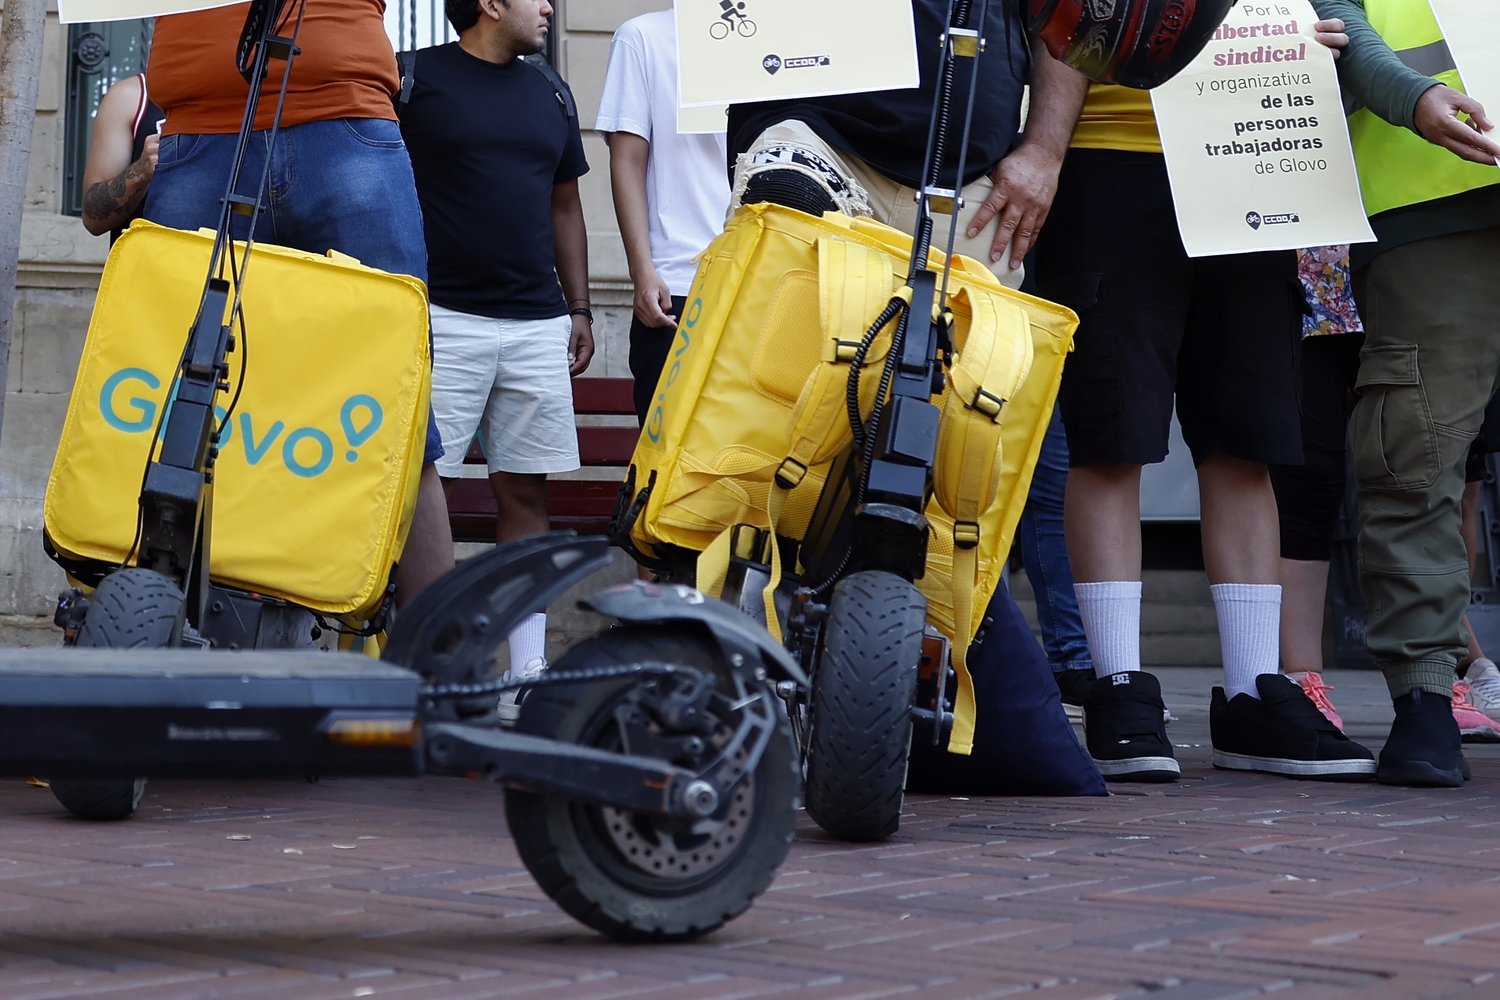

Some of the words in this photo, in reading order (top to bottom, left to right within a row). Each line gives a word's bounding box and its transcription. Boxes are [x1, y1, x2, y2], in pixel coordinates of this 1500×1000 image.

[1243, 4, 1270, 17] Por
[1274, 3, 1290, 16] la
[1210, 19, 1299, 42] ibertad
[1213, 43, 1306, 68] sindical
[1195, 81, 1205, 96] y
[1210, 71, 1311, 95] organizativa
[1260, 95, 1282, 110] de
[1287, 92, 1314, 108] las
[1234, 116, 1319, 136] personas
[1205, 136, 1323, 158] trabajadoras
[1254, 159, 1275, 175] de
[1279, 157, 1327, 174] Glovo
